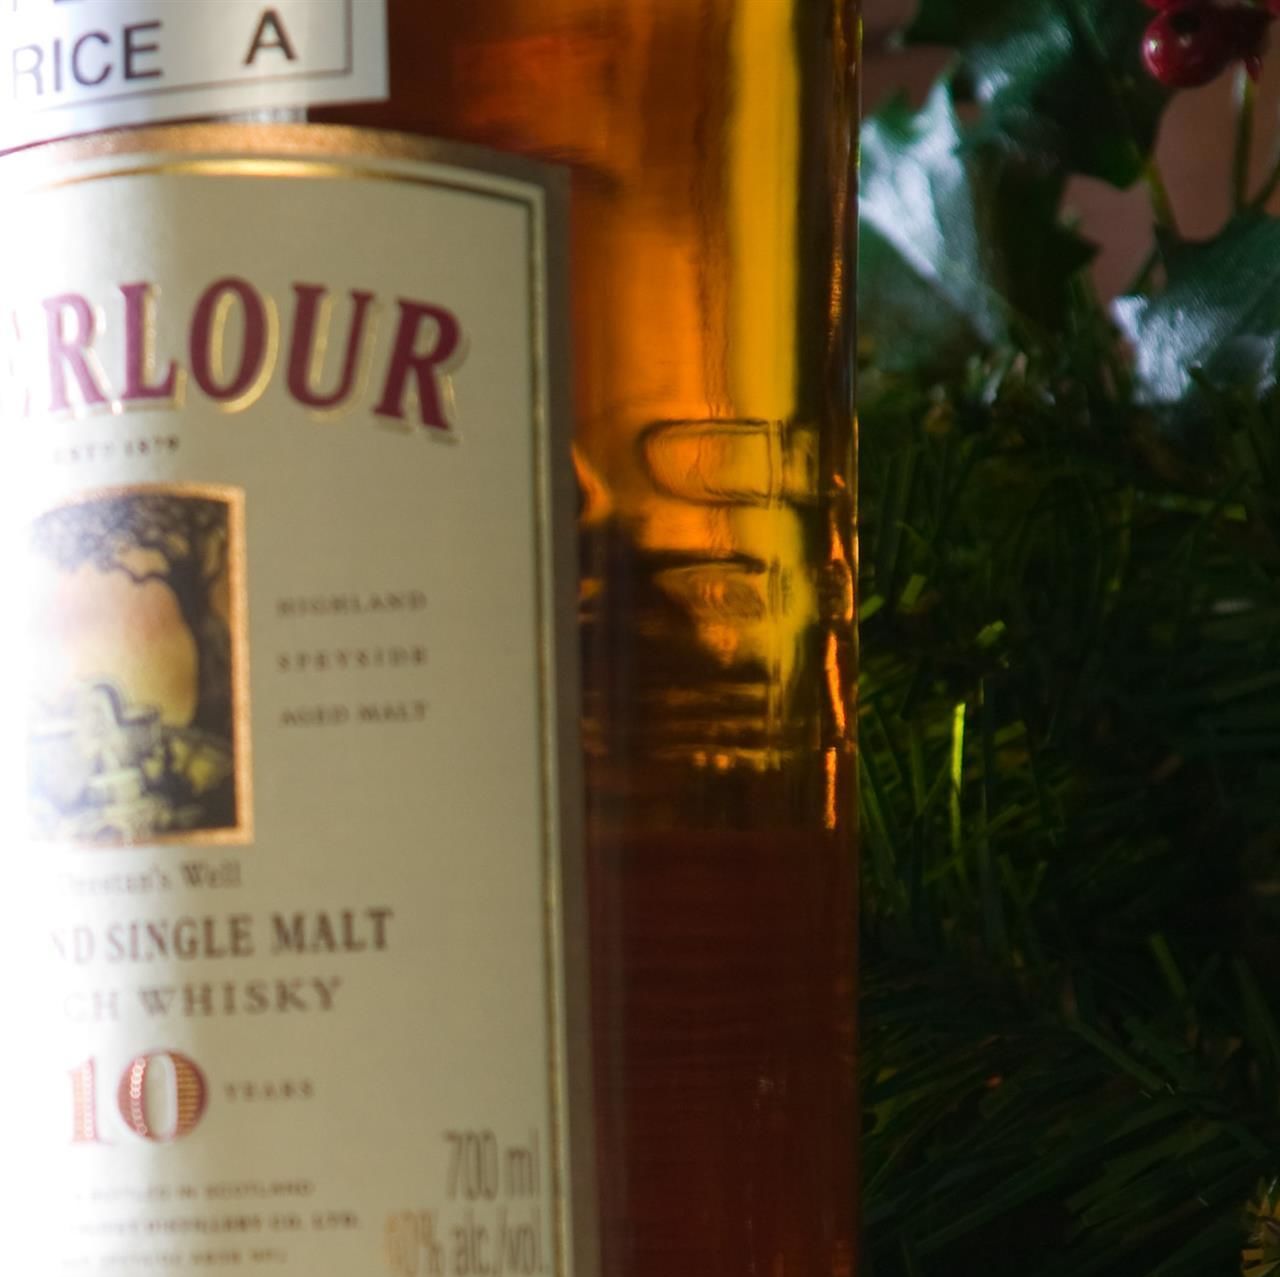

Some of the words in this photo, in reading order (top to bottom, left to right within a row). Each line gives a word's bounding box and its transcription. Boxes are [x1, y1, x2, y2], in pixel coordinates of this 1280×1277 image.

[244, 9, 297, 66] A
[20, 275, 466, 440] RLOUR
[107, 913, 255, 964] SINGLE
[271, 906, 394, 957] MALT
[136, 976, 343, 1018] WHISKY
[66, 1047, 210, 1147] 10
[442, 1127, 499, 1202] 700
